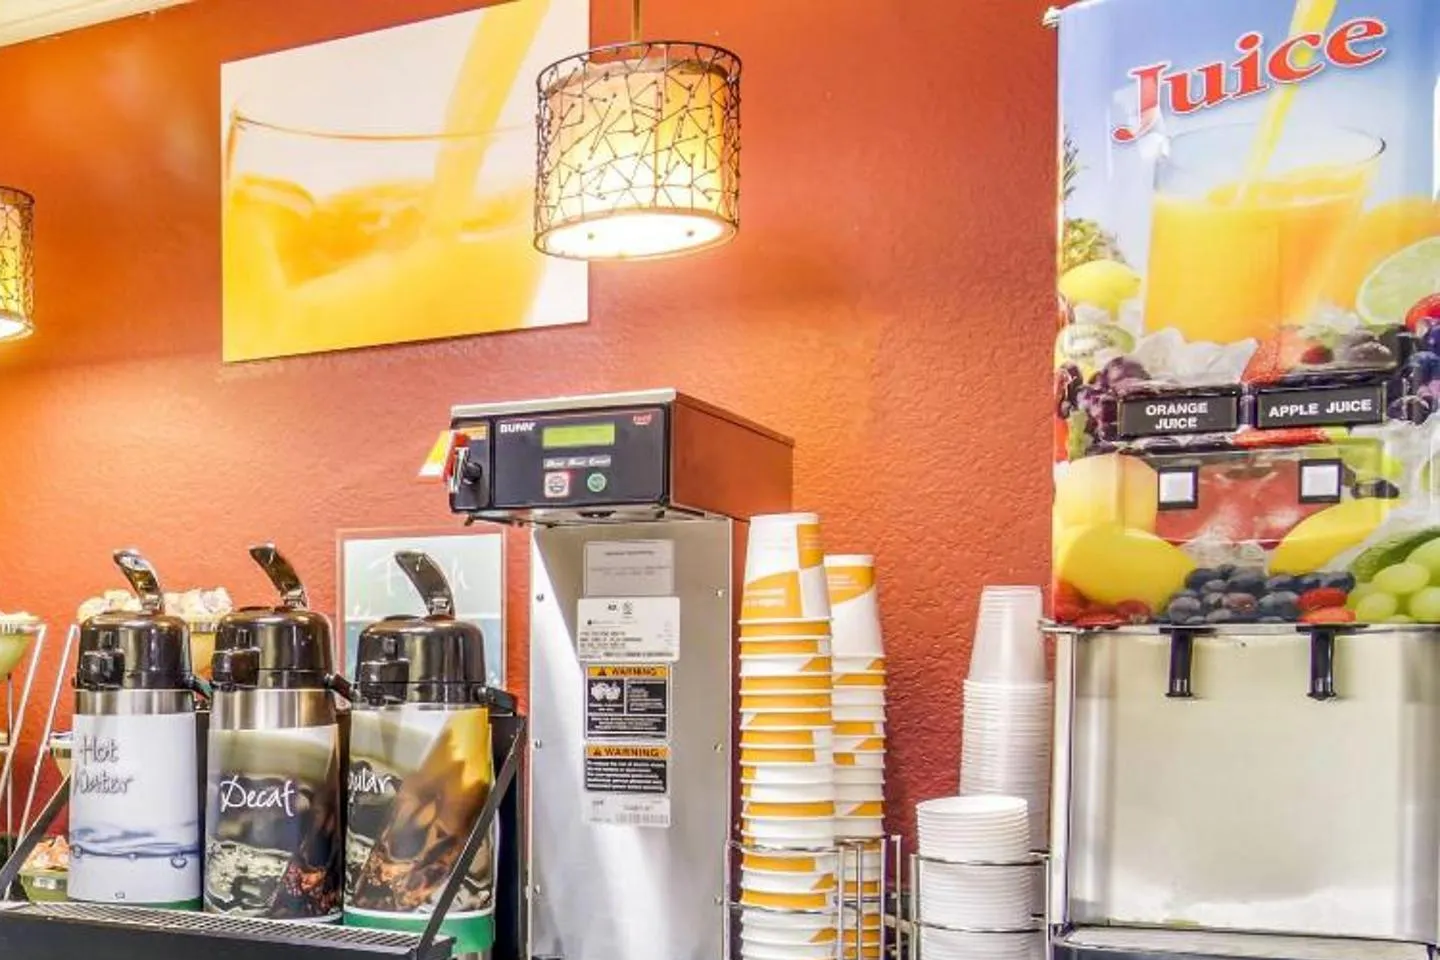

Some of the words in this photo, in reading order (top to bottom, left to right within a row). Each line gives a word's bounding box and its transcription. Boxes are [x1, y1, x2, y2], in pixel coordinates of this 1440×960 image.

[1112, 17, 1387, 142] Juice
[1145, 402, 1208, 416] ORANGE
[1268, 402, 1319, 418] APPLE
[1325, 399, 1372, 414] JUICE
[1154, 417, 1198, 430] JUICE
[79, 734, 120, 766] Hot
[604, 747, 660, 758] WARNING
[220, 775, 295, 817] Decaf
[348, 767, 392, 803] gular
